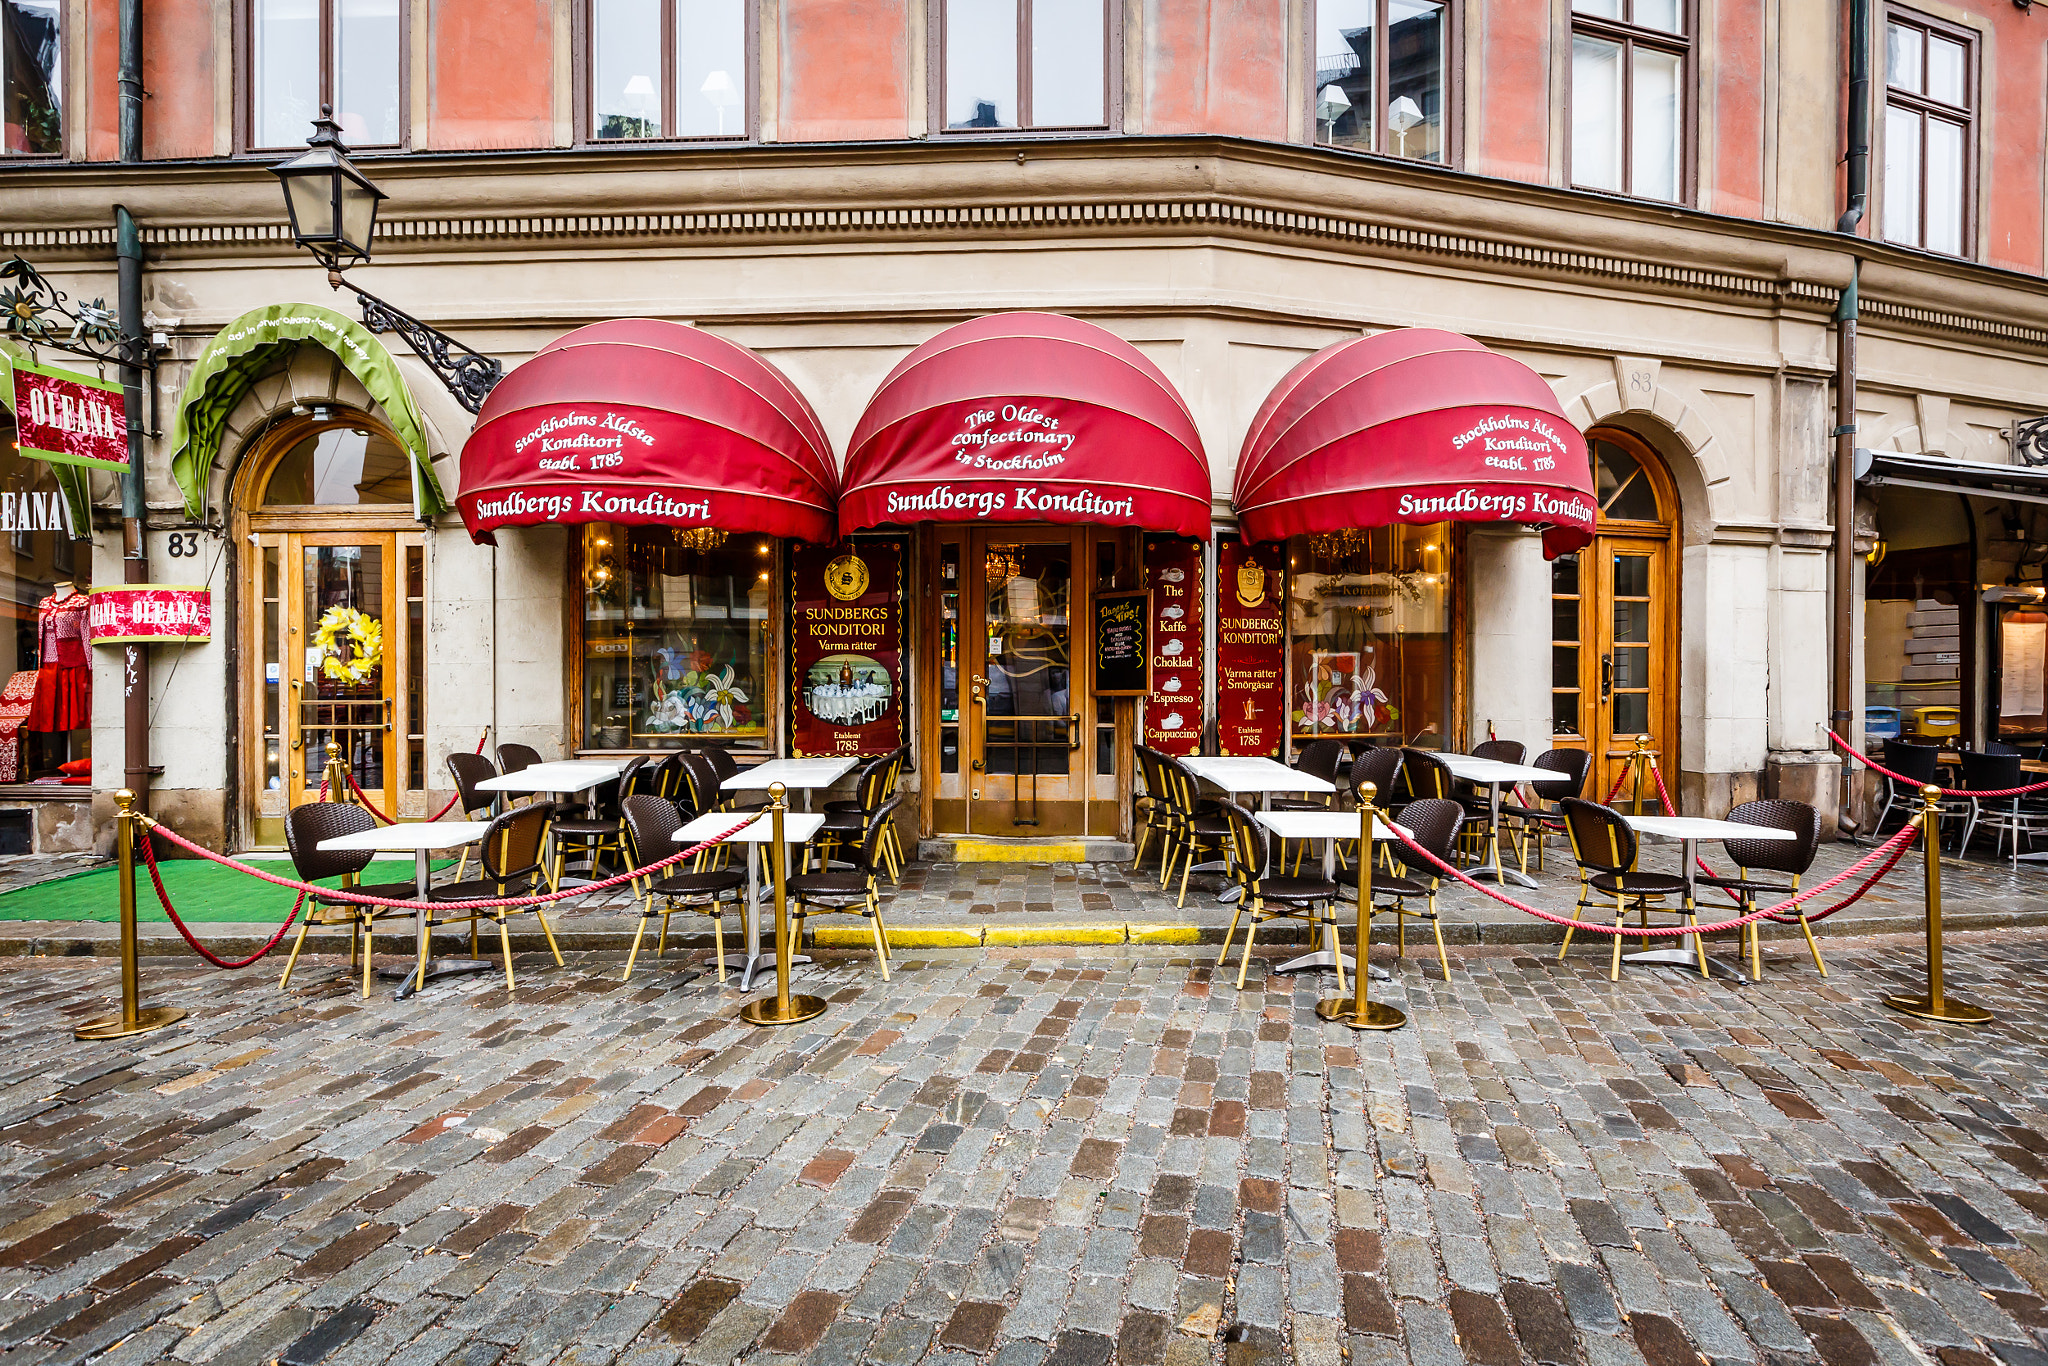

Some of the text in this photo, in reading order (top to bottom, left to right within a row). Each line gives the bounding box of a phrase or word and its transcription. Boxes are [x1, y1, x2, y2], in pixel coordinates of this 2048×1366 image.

[1631, 371, 1651, 392] 83
[30, 387, 116, 440] OLEANA
[965, 404, 1059, 430] The Oldest
[514, 411, 656, 453] Stockholms Äldsta
[951, 428, 1076, 450] confectionary
[1452, 414, 1568, 454] Stockholms Äldsta
[540, 433, 623, 453] Konditori
[1484, 437, 1552, 453] Konditori
[538, 451, 624, 471] etabl. 1785
[955, 448, 1065, 471] in Stockholm
[1484, 455, 1556, 473] etabl. 1785
[476, 491, 711, 521] Sundbergs Konditori
[887, 486, 1134, 518] Sundbergs Konditori
[1398, 488, 1594, 526] Sundbergs Konditori
[168, 532, 199, 558] 83
[132, 600, 200, 625] OLEANA
[806, 608, 888, 620] SUNDBERGS
[809, 624, 885, 636] KONDITORI
[1160, 621, 1187, 632] Kaffe
[1221, 618, 1279, 630] SUNDBERGS
[818, 639, 877, 651] Varma rätter
[1223, 633, 1278, 644] KONDITORI
[1153, 656, 1193, 668] Choklad
[1224, 667, 1277, 678] Varma rätter
[1227, 678, 1275, 692] Smörgåsar
[1153, 692, 1194, 706] Espresso
[1148, 728, 1198, 744] Cappuccino
[1239, 735, 1261, 746] 1785
[836, 740, 859, 751] 1785
